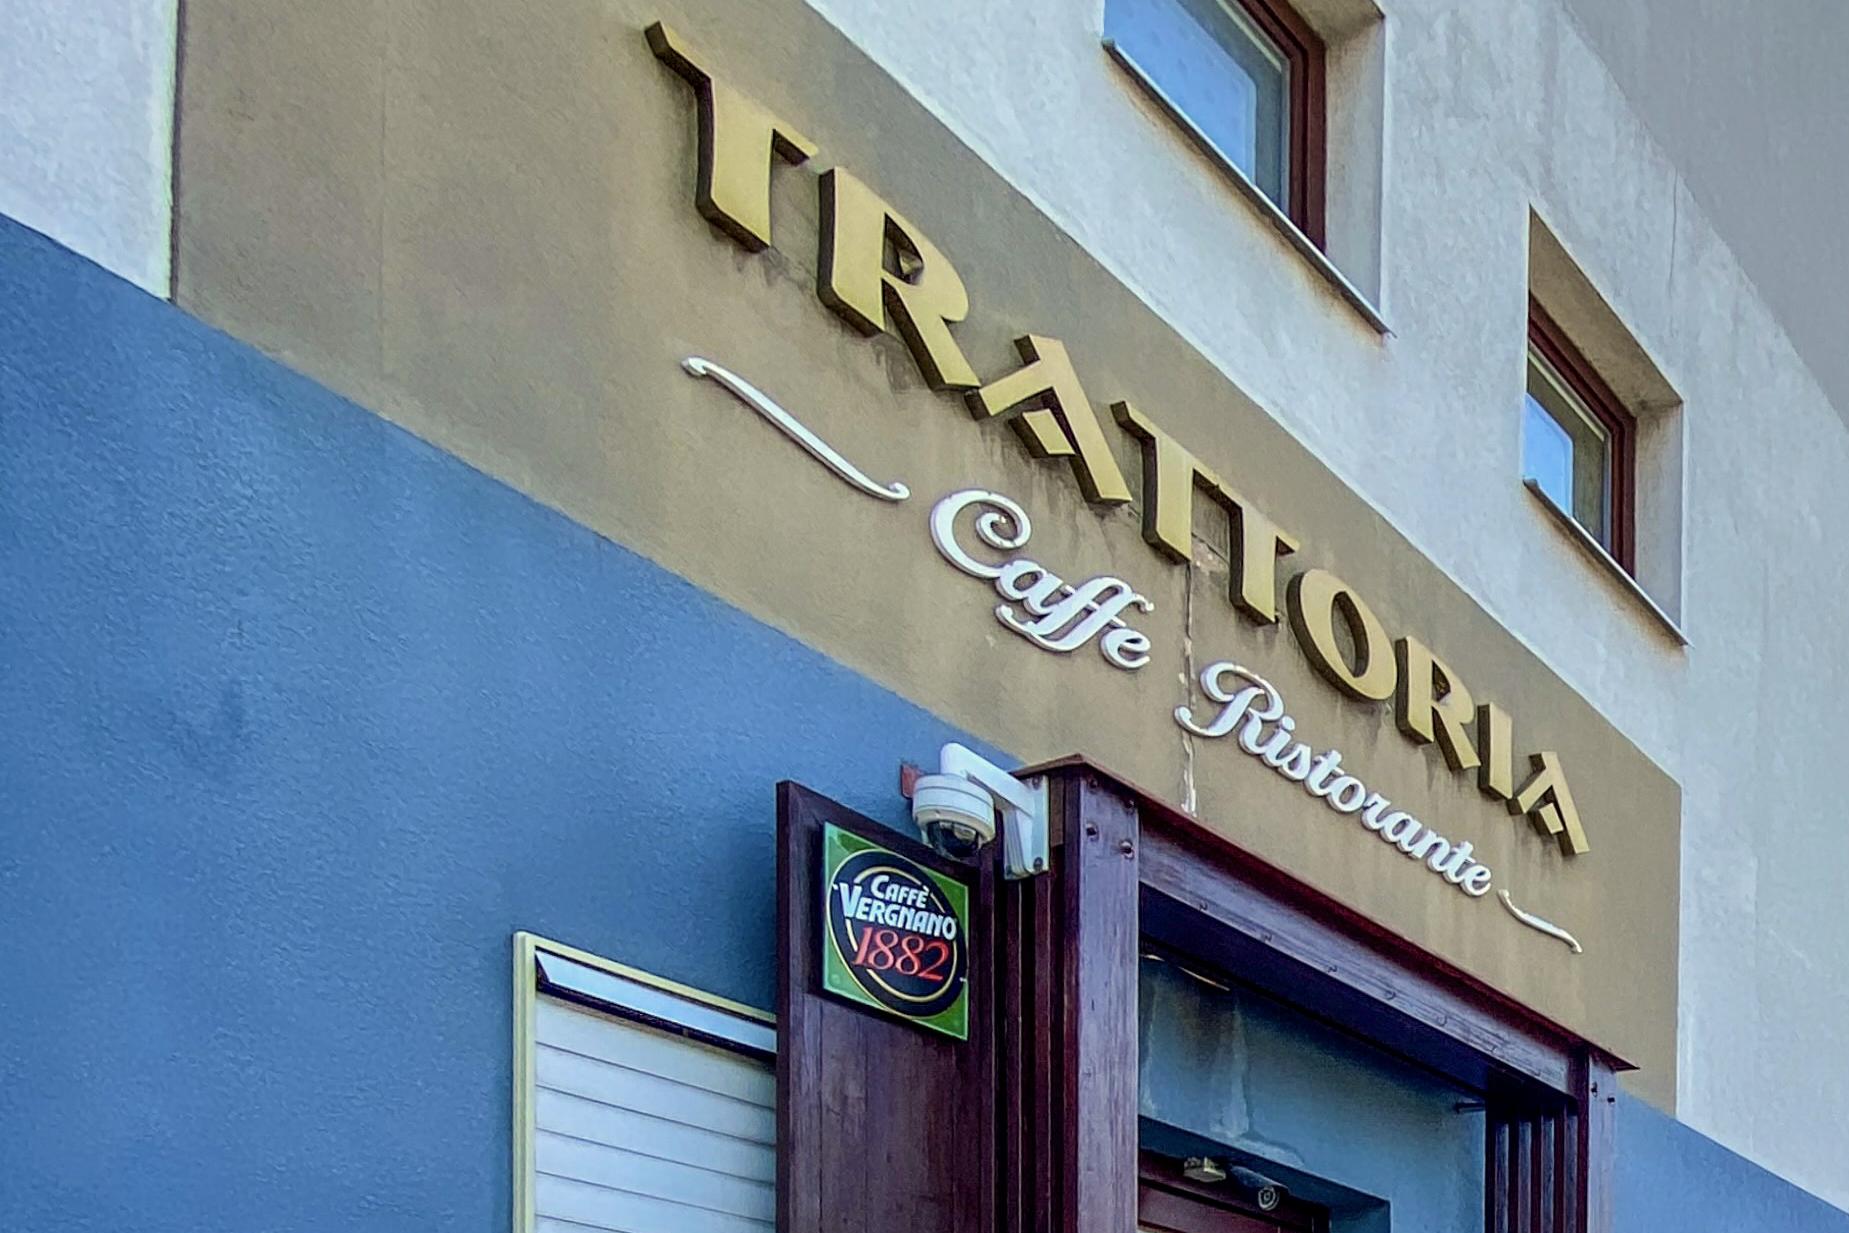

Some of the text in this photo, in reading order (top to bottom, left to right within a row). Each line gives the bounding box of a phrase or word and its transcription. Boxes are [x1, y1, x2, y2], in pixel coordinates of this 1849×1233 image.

[645, 19, 1591, 858] TRATTORIA
[931, 489, 1491, 898] Caffe Ristorante
[832, 882, 958, 941] VERGNANO
[851, 926, 950, 982] 1882
